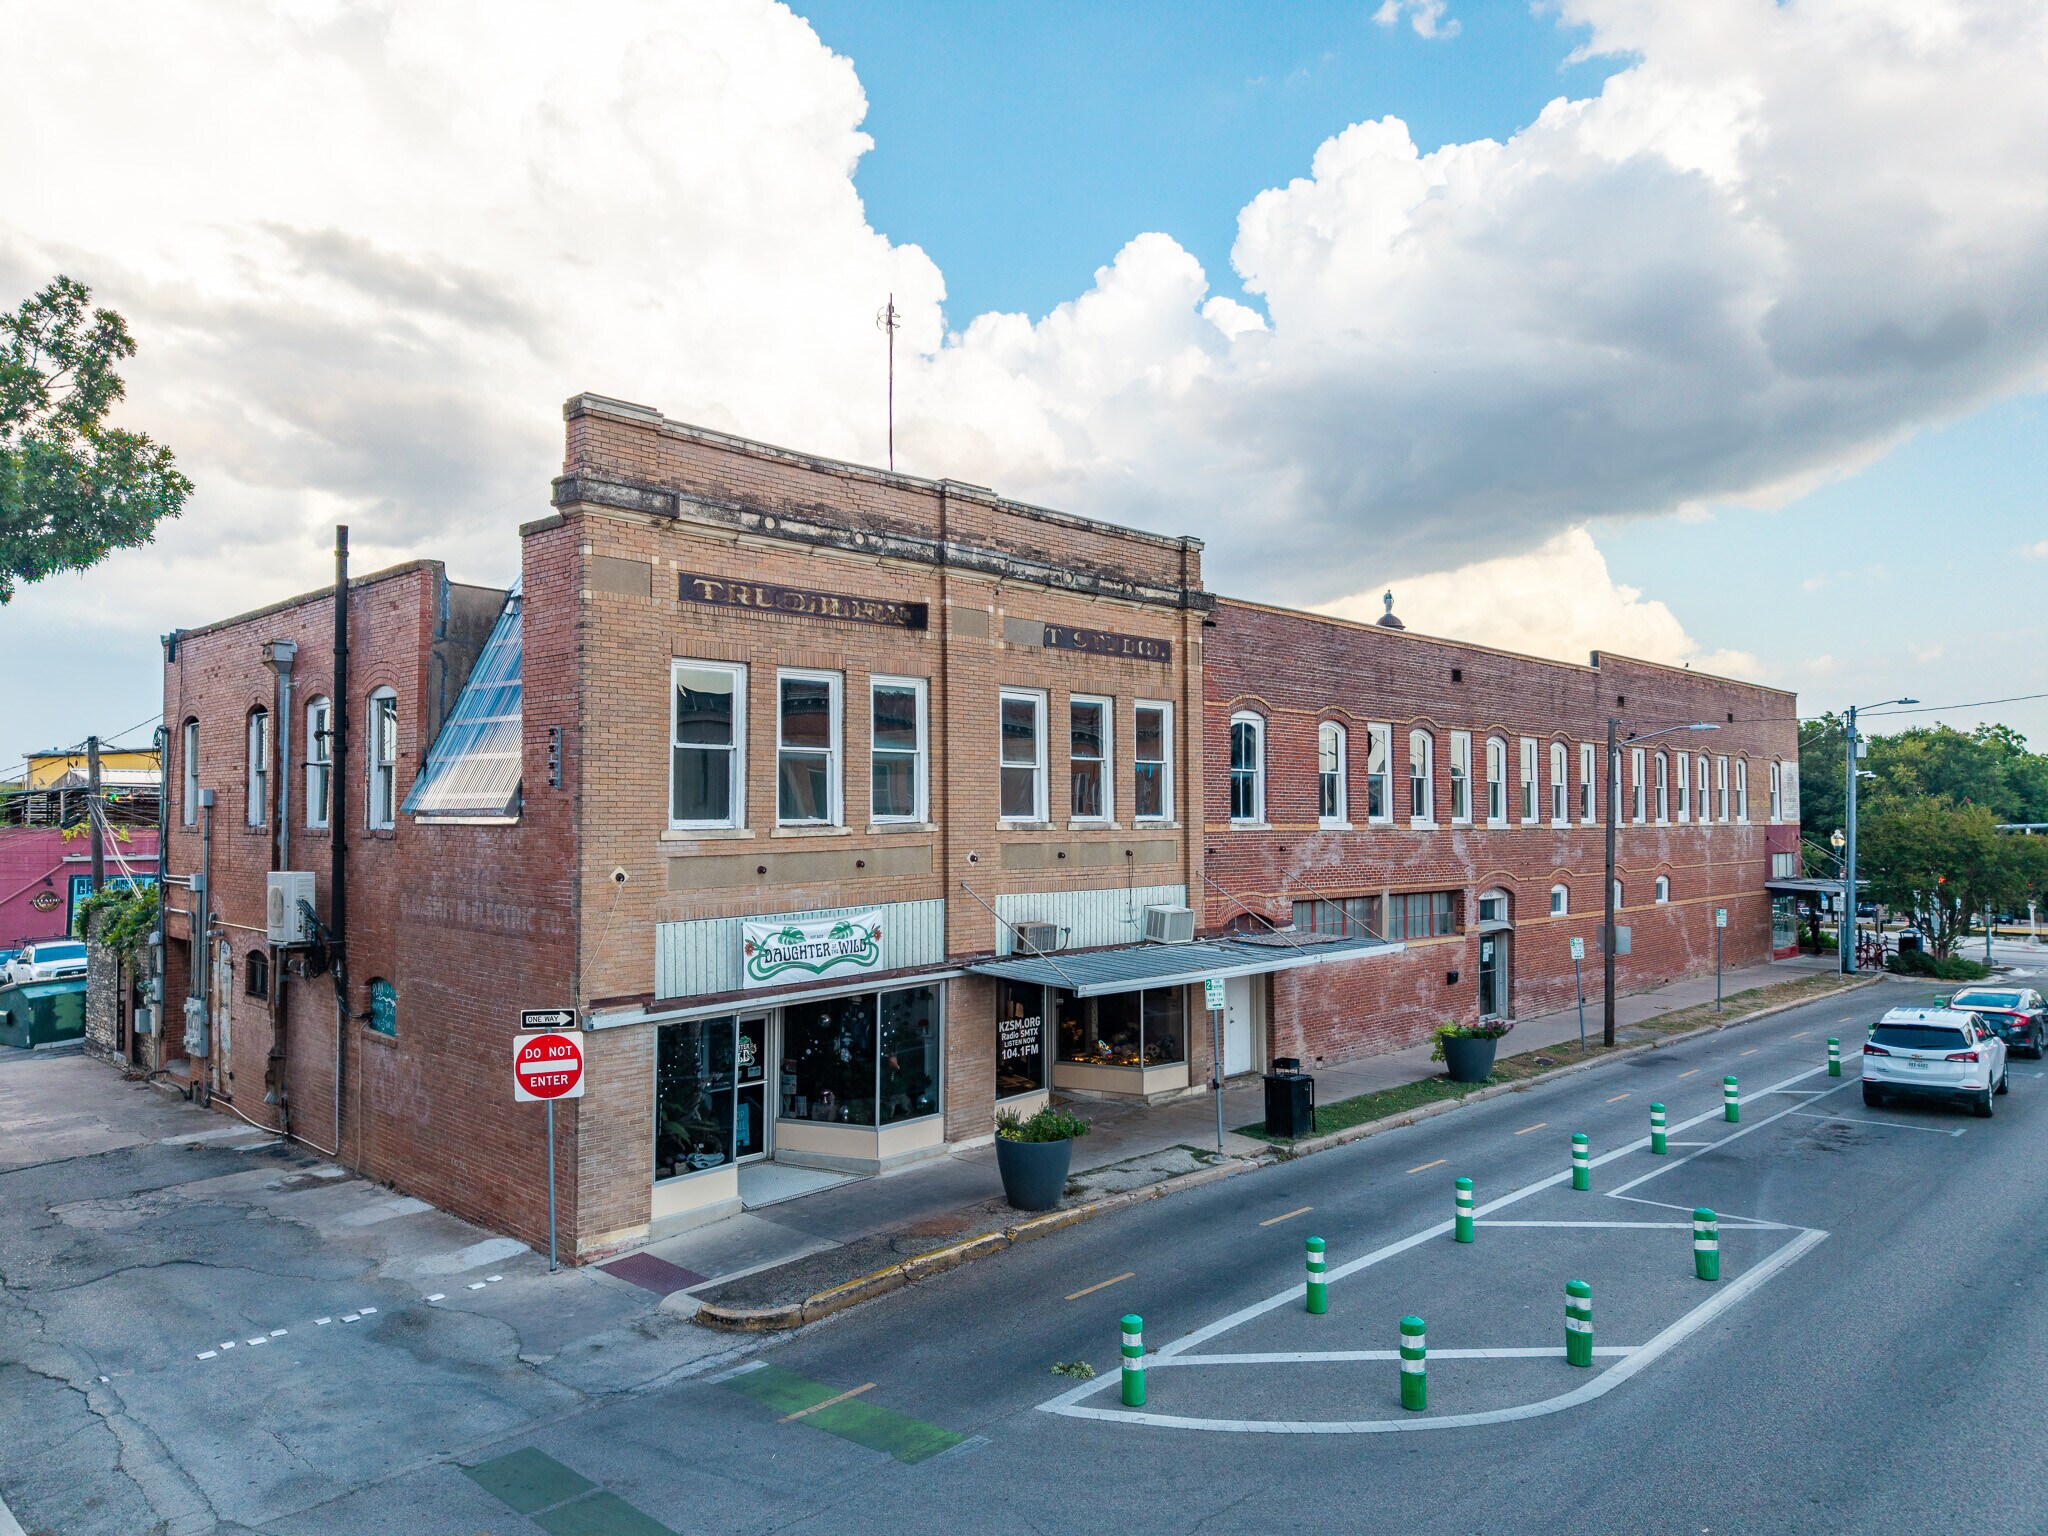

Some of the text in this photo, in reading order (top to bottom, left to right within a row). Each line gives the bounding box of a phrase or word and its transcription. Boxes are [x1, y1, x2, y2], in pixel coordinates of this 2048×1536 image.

[764, 942, 831, 963] DAUGHTER
[838, 938, 867, 954] WILD
[1206, 980, 1211, 989] 2
[527, 1015, 542, 1023] ONE
[998, 1016, 1041, 1032] KZSM.ORG
[1001, 1027, 1038, 1041] Radio SMTX
[1004, 1036, 1035, 1048] LISTEN NOW
[525, 1045, 572, 1059] DO NOT
[1001, 1043, 1039, 1060] 104.1FM
[530, 1074, 568, 1087] ENTER
